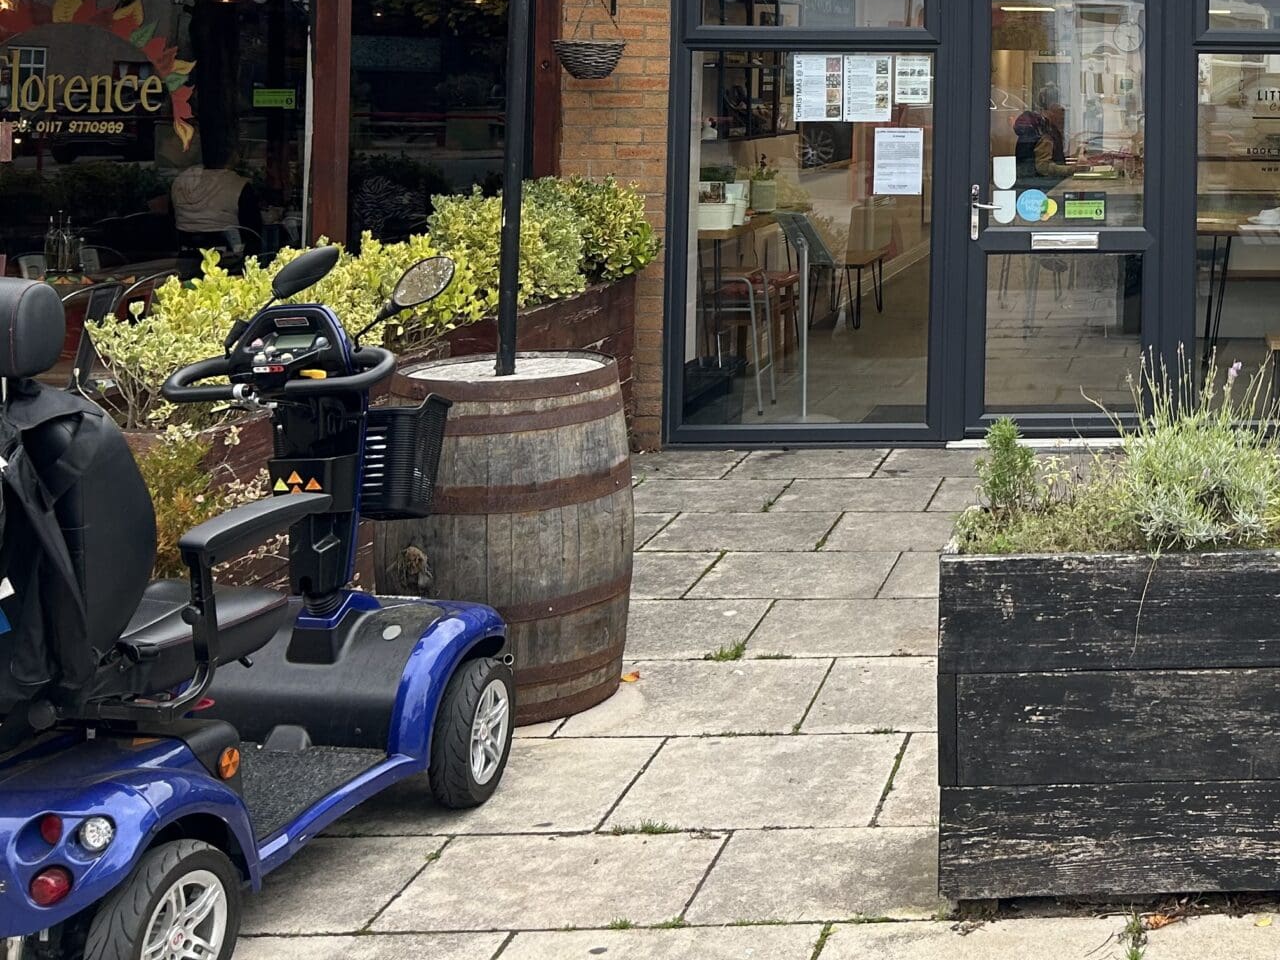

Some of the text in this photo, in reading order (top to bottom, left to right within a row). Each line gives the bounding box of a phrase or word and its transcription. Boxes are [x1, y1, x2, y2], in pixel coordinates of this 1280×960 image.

[0, 48, 163, 113] lorence
[36, 120, 62, 133] 0117
[1246, 147, 1272, 155] BOOK
